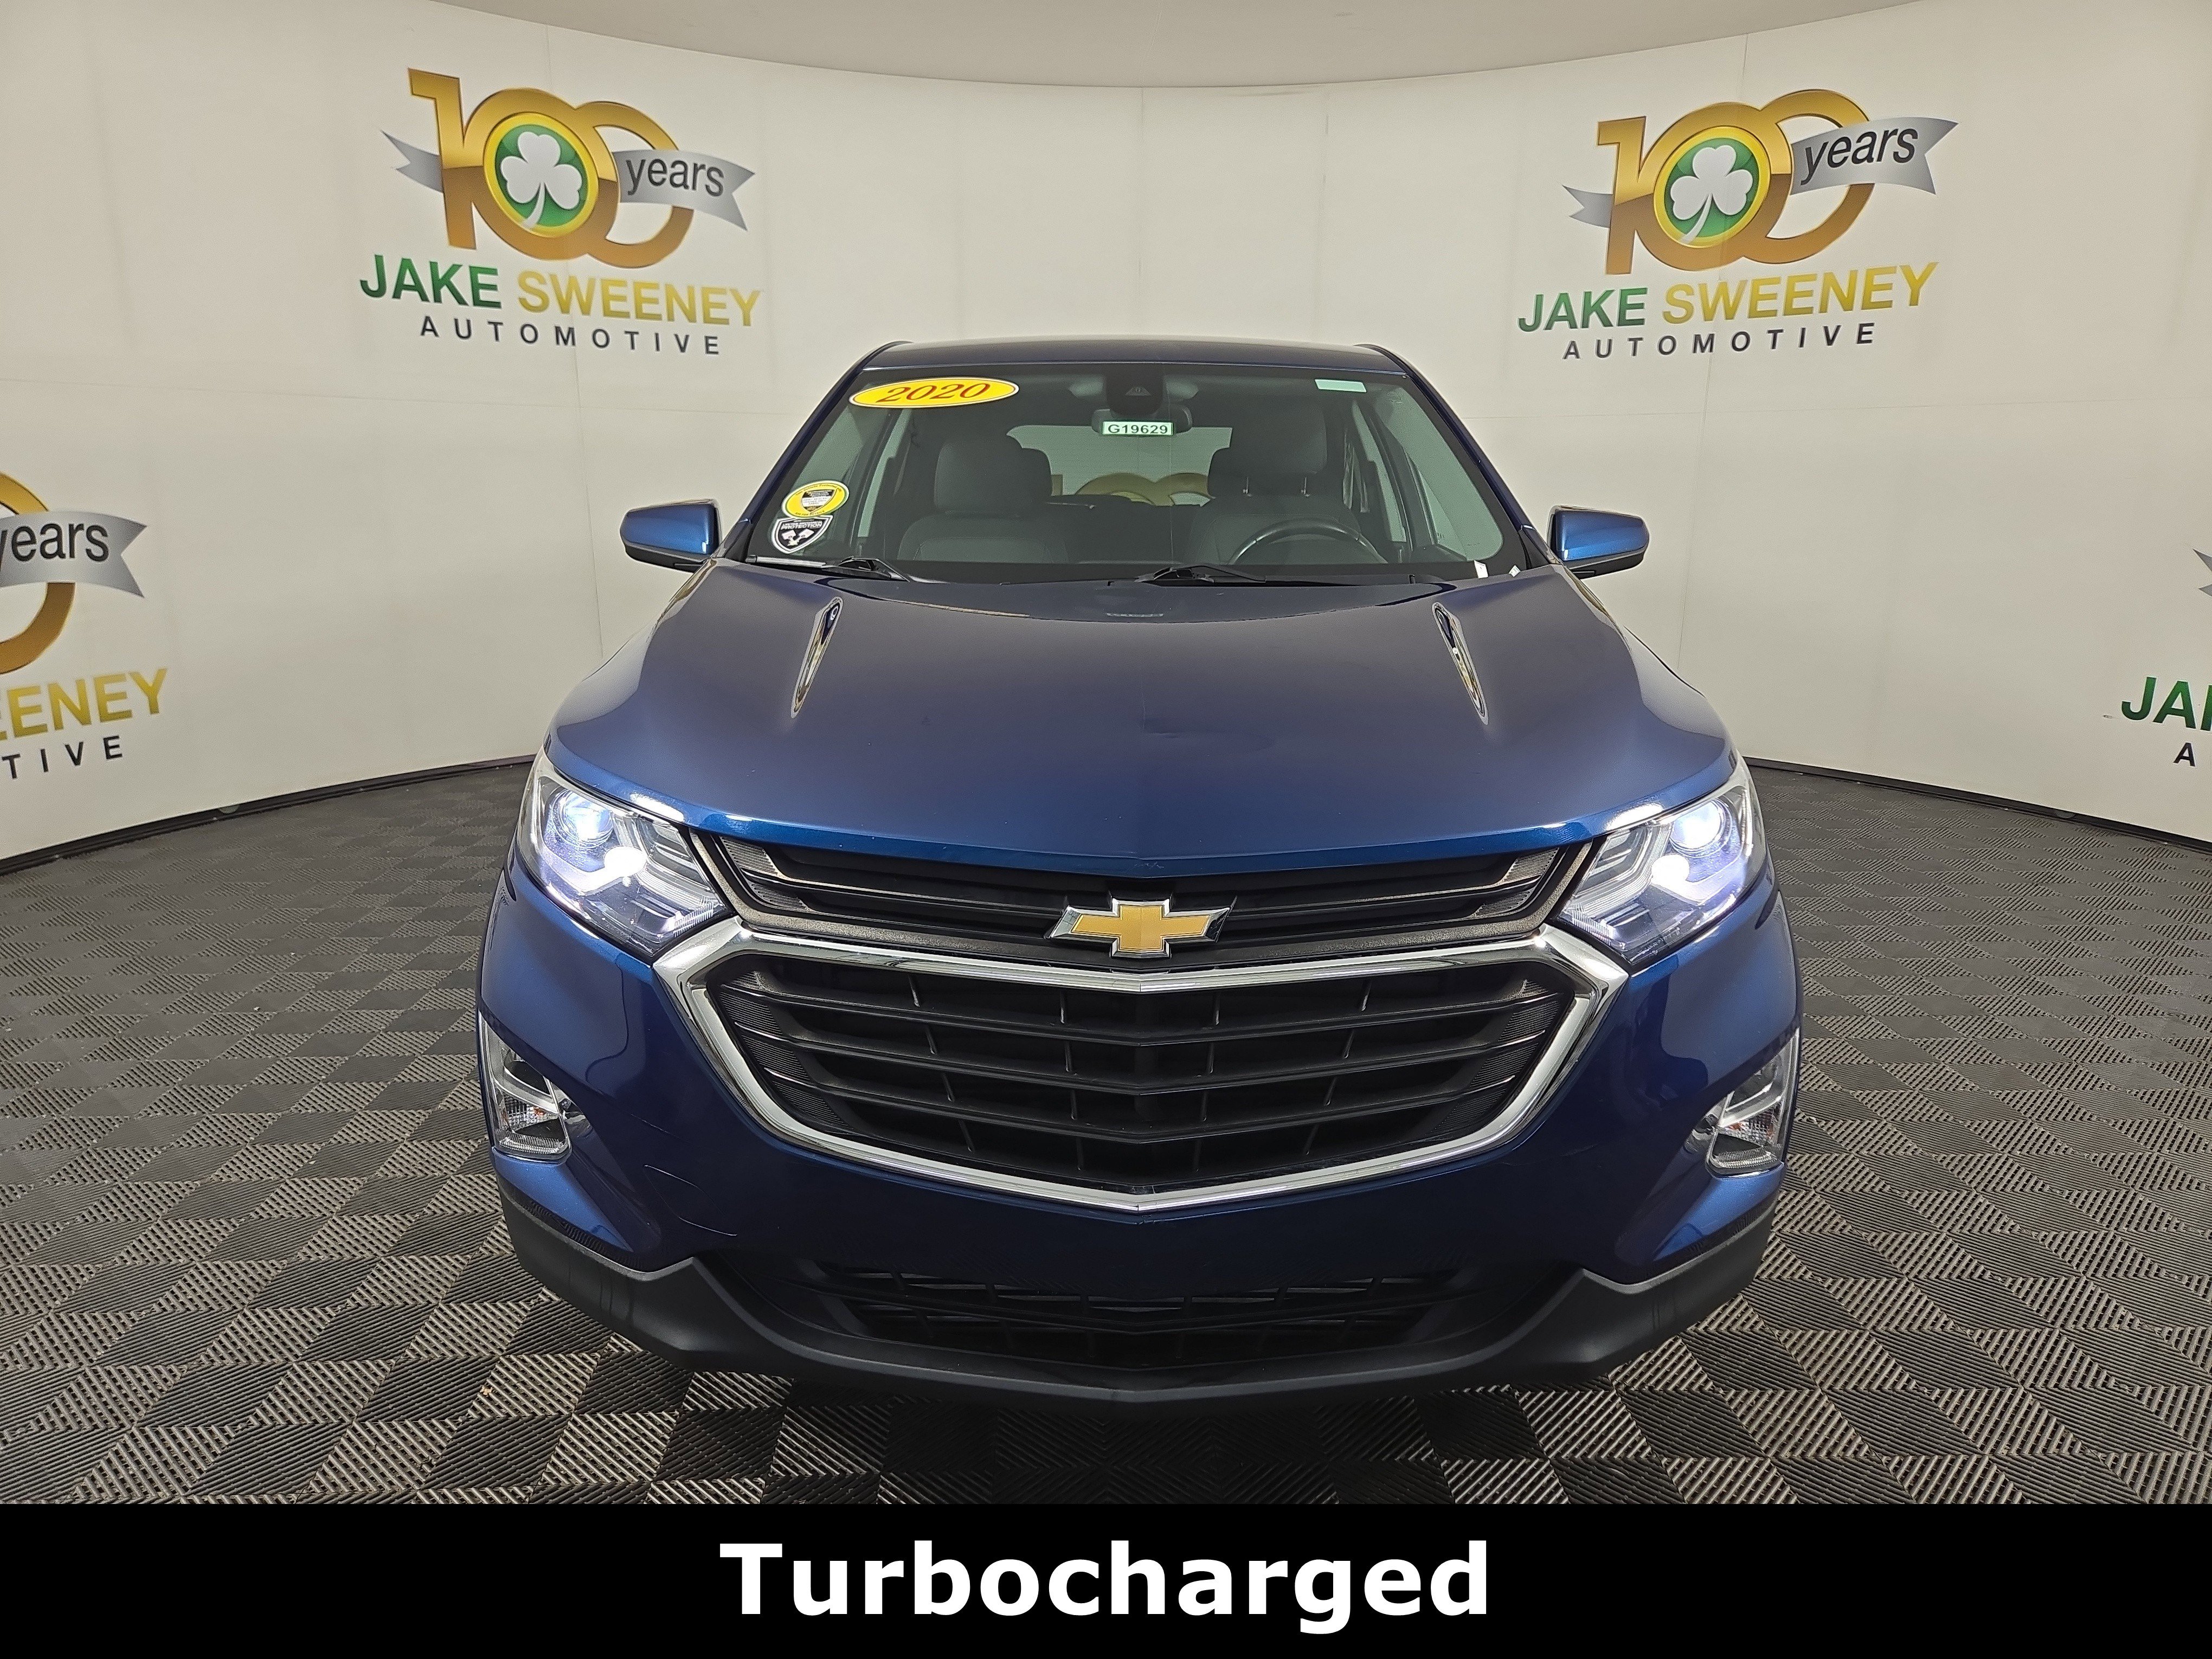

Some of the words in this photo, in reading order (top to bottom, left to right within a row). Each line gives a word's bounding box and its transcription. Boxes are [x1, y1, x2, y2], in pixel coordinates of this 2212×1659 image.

[408, 68, 694, 269] 100
[626, 157, 725, 197] years
[1597, 89, 1875, 275] 100
[1800, 127, 1919, 185] years
[359, 254, 501, 309] JAKE
[517, 271, 761, 326] SWEENEY
[1518, 287, 1648, 332] JAKE
[1663, 261, 1939, 324] SWEENEY
[420, 316, 719, 355] AUTOMOTIVE
[1562, 323, 1875, 360] AUTOMOTIVE
[876, 383, 991, 403] 2020
[1108, 424, 1168, 434] G19629
[0, 668, 168, 741] ENEY
